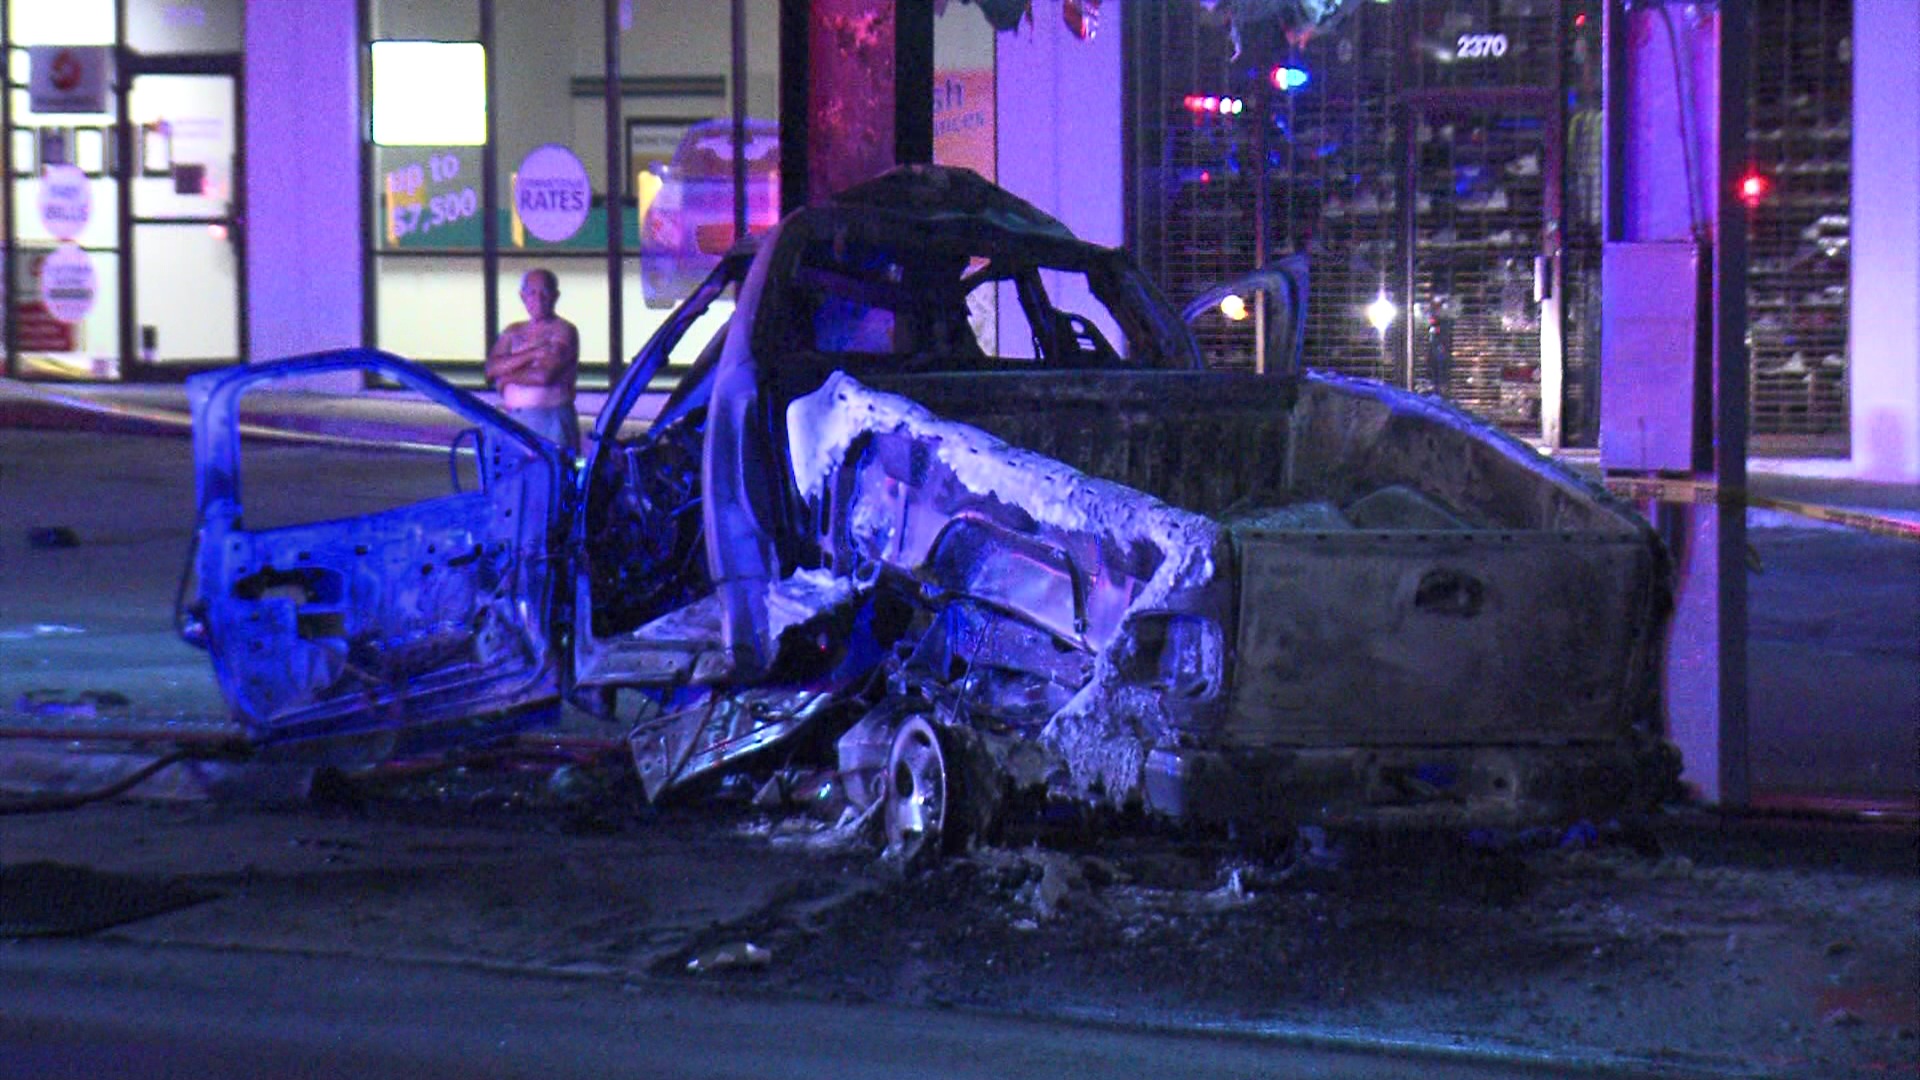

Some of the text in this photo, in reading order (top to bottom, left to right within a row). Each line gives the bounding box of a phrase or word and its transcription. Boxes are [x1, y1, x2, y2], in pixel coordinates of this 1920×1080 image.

[1457, 33, 1508, 57] 2370
[388, 152, 459, 195] up to
[520, 189, 584, 210] RATES
